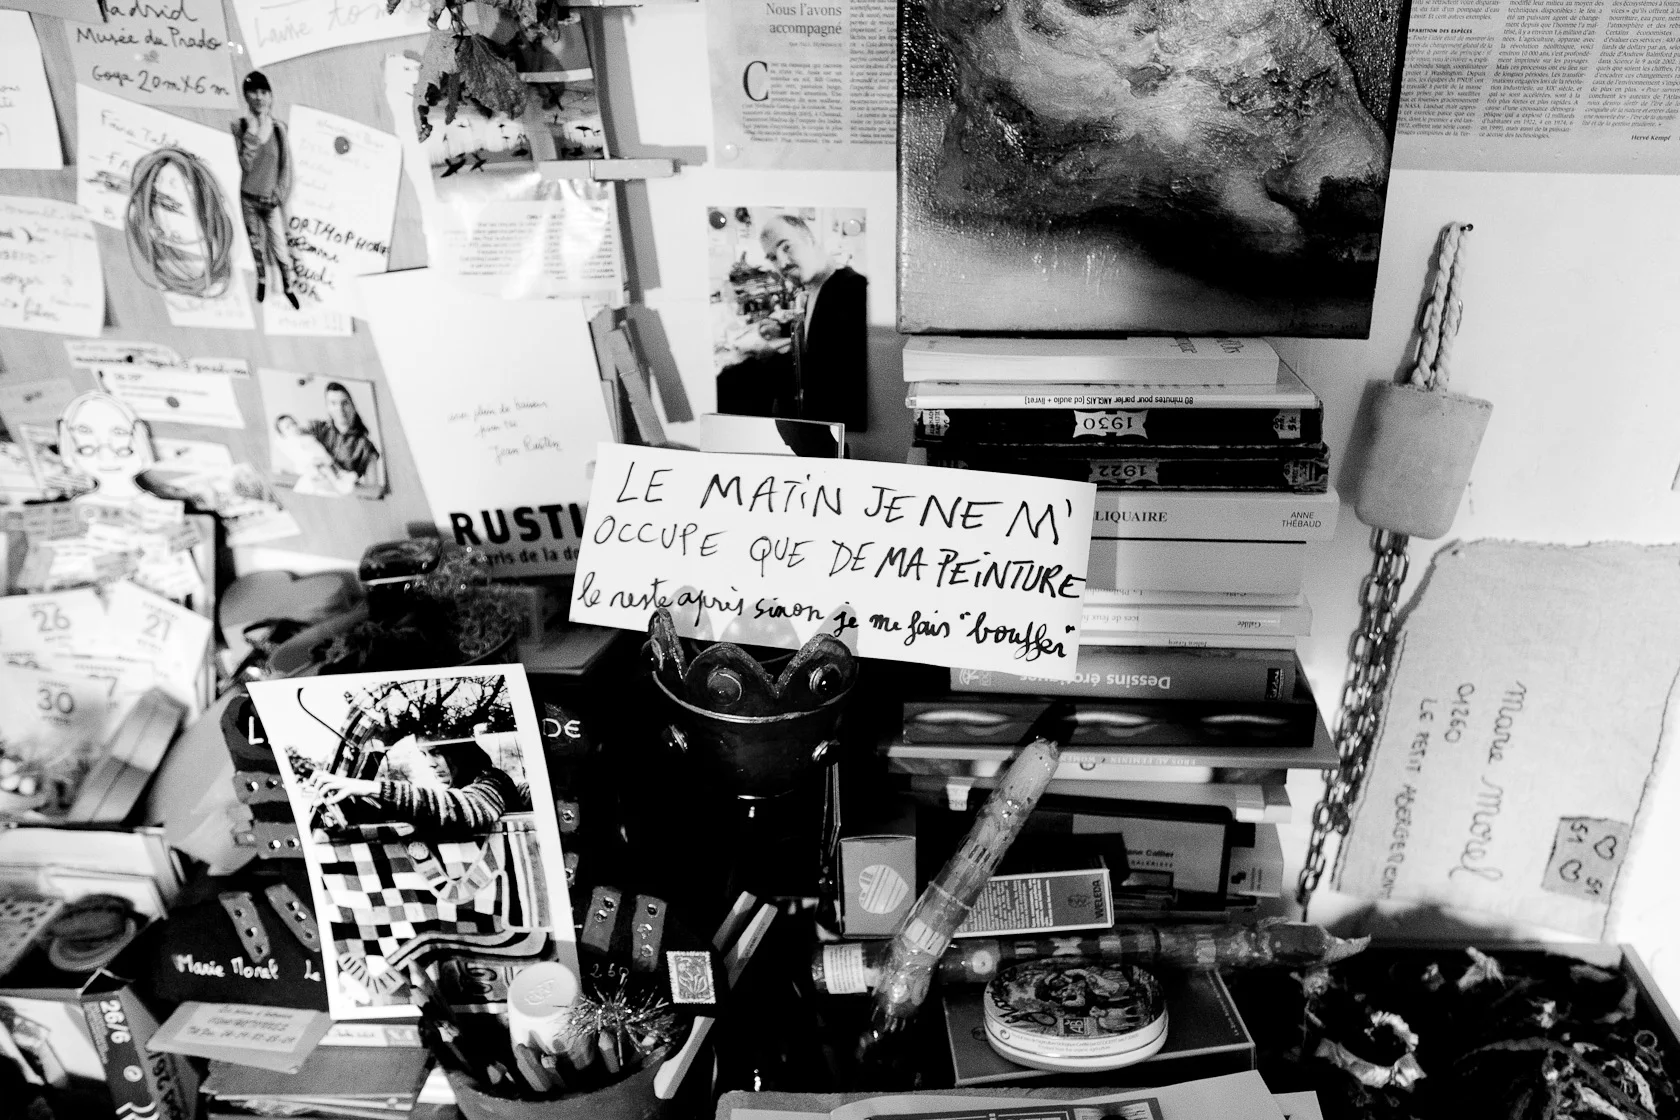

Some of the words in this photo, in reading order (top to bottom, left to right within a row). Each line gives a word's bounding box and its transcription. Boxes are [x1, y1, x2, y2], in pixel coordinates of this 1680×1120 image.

[766, 3, 796, 16] Nous
[800, 3, 842, 16] l'avons
[76, 27, 138, 46] Musée
[145, 29, 167, 46] du
[168, 26, 221, 50] Prado
[769, 21, 842, 37] accompagné
[1054, 396, 1072, 405] audio
[1086, 396, 1112, 406] ANGLAIS
[1114, 395, 1136, 405] parler
[1136, 395, 1153, 404] pour
[1154, 396, 1184, 404] minutes
[1184, 396, 1194, 405] 80
[1082, 415, 1134, 432] 1930
[1098, 464, 1148, 478] 1922
[616, 462, 673, 502] LE
[864, 485, 916, 523] JE
[920, 494, 1004, 529] NE
[1006, 498, 1072, 546] M'
[1282, 519, 1322, 528] THÉBAUD
[542, 547, 558, 562] la
[594, 515, 729, 557] OCCUPE
[749, 535, 816, 578] QUE
[828, 539, 875, 578] DE
[874, 546, 928, 581] MA
[32, 608, 71, 632] 26
[577, 572, 602, 608] le
[610, 578, 674, 611] reste
[678, 586, 744, 628] après
[754, 597, 825, 622] sinon
[833, 600, 859, 638] je
[869, 613, 902, 633] me
[904, 610, 950, 646] fais
[142, 613, 172, 642] 21
[1106, 673, 1171, 690] Dessins
[38, 688, 74, 714] 30
[1419, 698, 1438, 722] LE
[1444, 683, 1476, 744] 01260
[1487, 680, 1527, 764] Marie
[1406, 732, 1430, 774] PETIT
[1448, 776, 1504, 883] Morel
[1092, 880, 1104, 918] WELEDA
[172, 954, 226, 978] Marie
[100, 999, 132, 1044] 26/6
